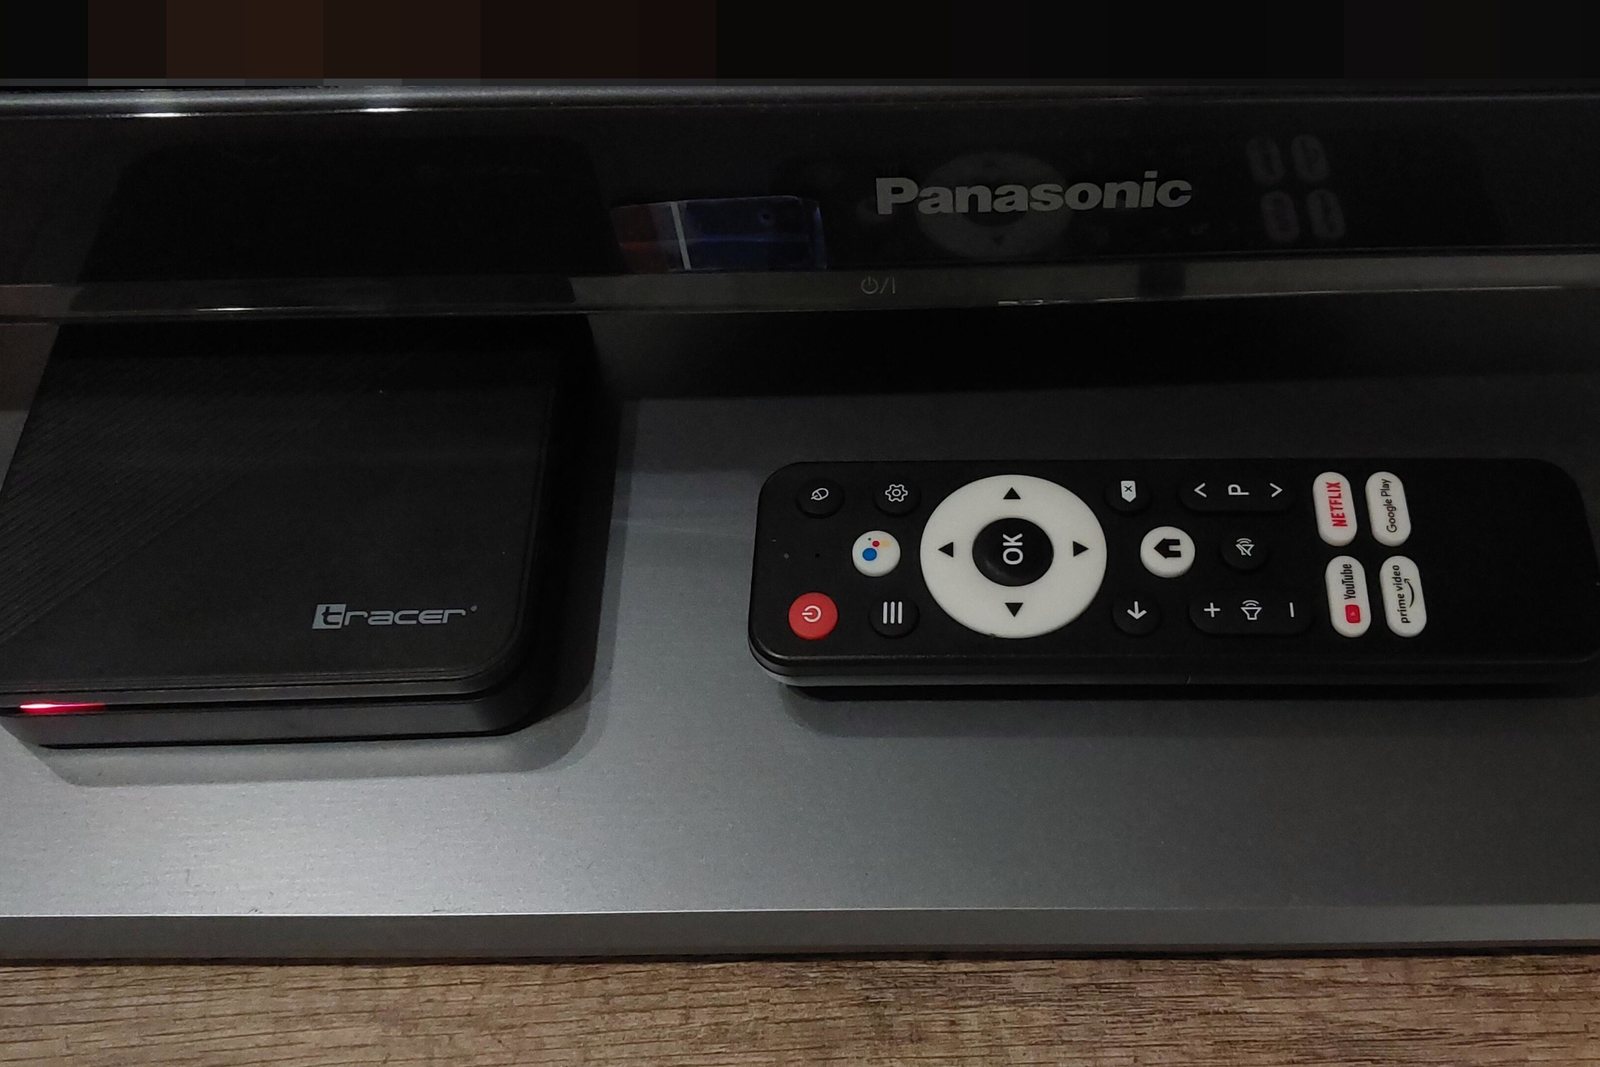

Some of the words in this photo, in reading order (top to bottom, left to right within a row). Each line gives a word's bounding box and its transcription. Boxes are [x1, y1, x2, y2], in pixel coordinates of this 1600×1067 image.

[875, 170, 1193, 215] Panasonic
[1227, 483, 1250, 496] P
[1380, 478, 1392, 497] Play
[1325, 481, 1348, 527] NETFLIX
[1382, 498, 1398, 533] Google
[1002, 532, 1024, 566] OK
[1341, 563, 1356, 600] YouTube
[1390, 565, 1404, 592] video
[311, 603, 467, 630] tracer
[1396, 594, 1411, 624] prime
